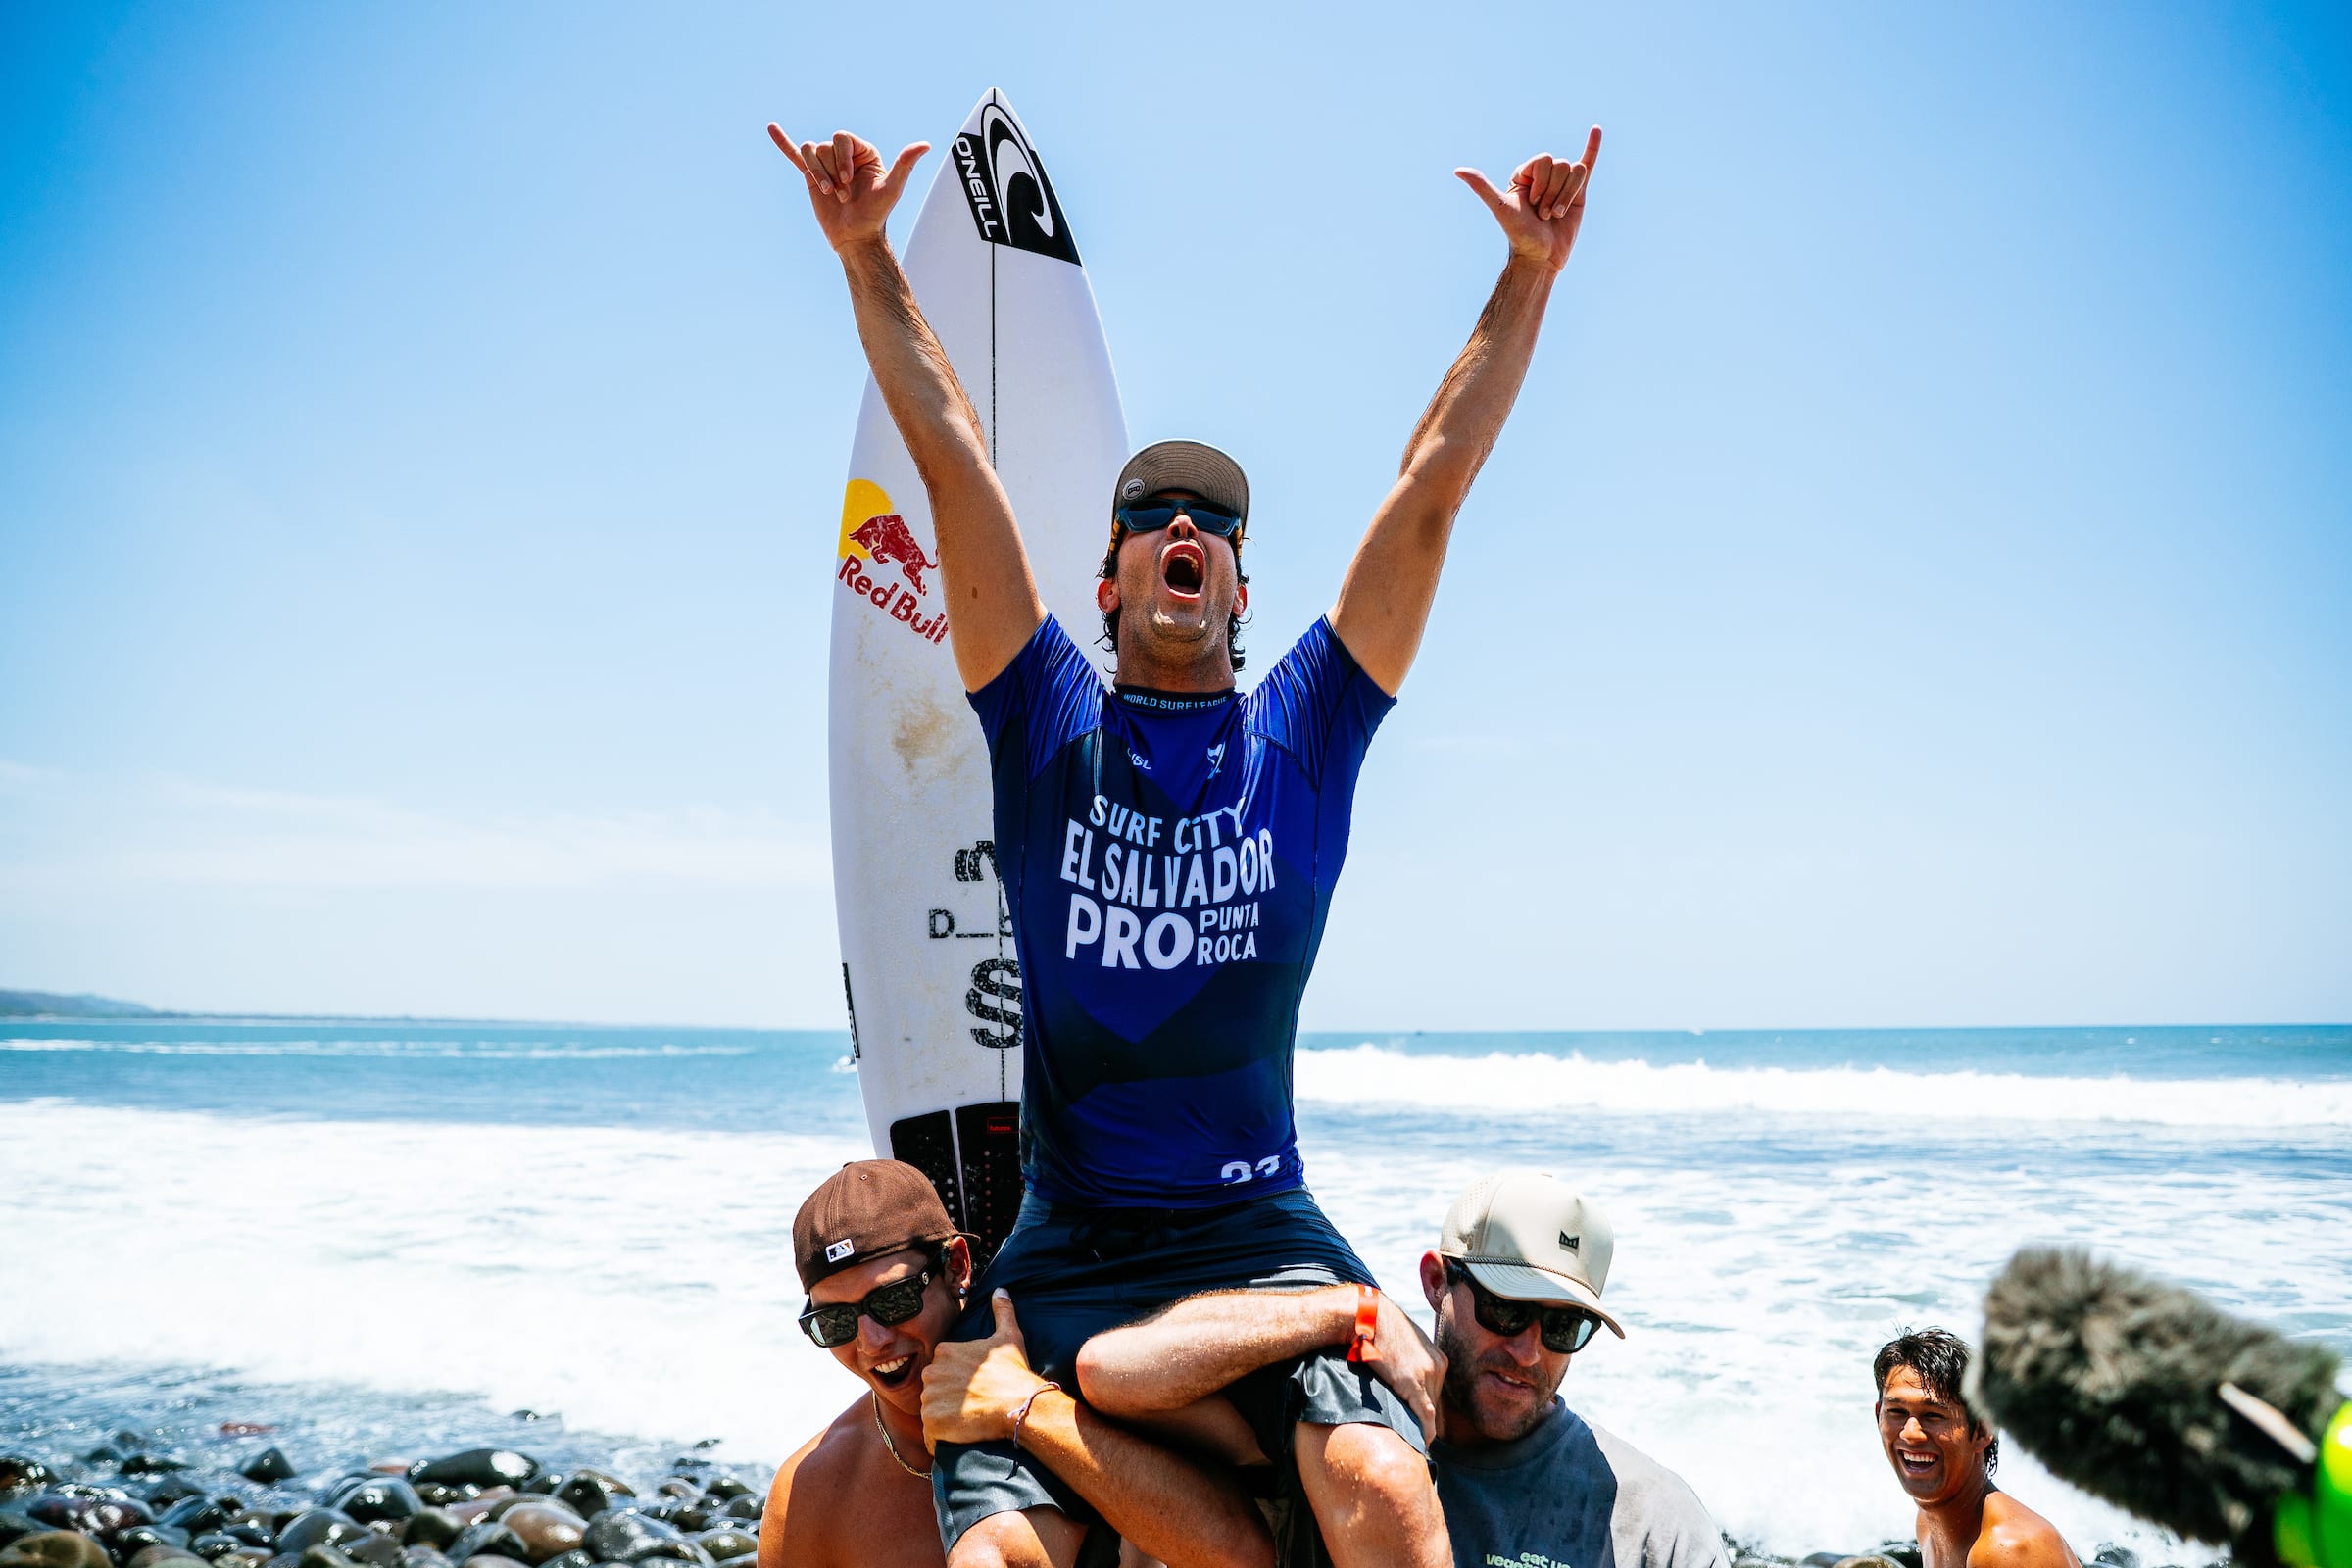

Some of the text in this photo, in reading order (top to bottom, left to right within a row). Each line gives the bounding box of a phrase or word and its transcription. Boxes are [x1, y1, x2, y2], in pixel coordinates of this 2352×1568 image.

[956, 136, 1001, 238] O'NEILL
[838, 554, 949, 646] Red Bull
[1123, 693, 1157, 707] WORLD
[1159, 699, 1193, 710] SURF
[1089, 794, 1163, 847] SURF
[1060, 818, 1095, 891] EL
[1101, 828, 1276, 908] SALVADOR
[1065, 893, 1195, 970] PRO
[1199, 901, 1259, 934] PUNTA
[1196, 931, 1257, 966] ROCA
[1519, 1551, 1549, 1568] eat
